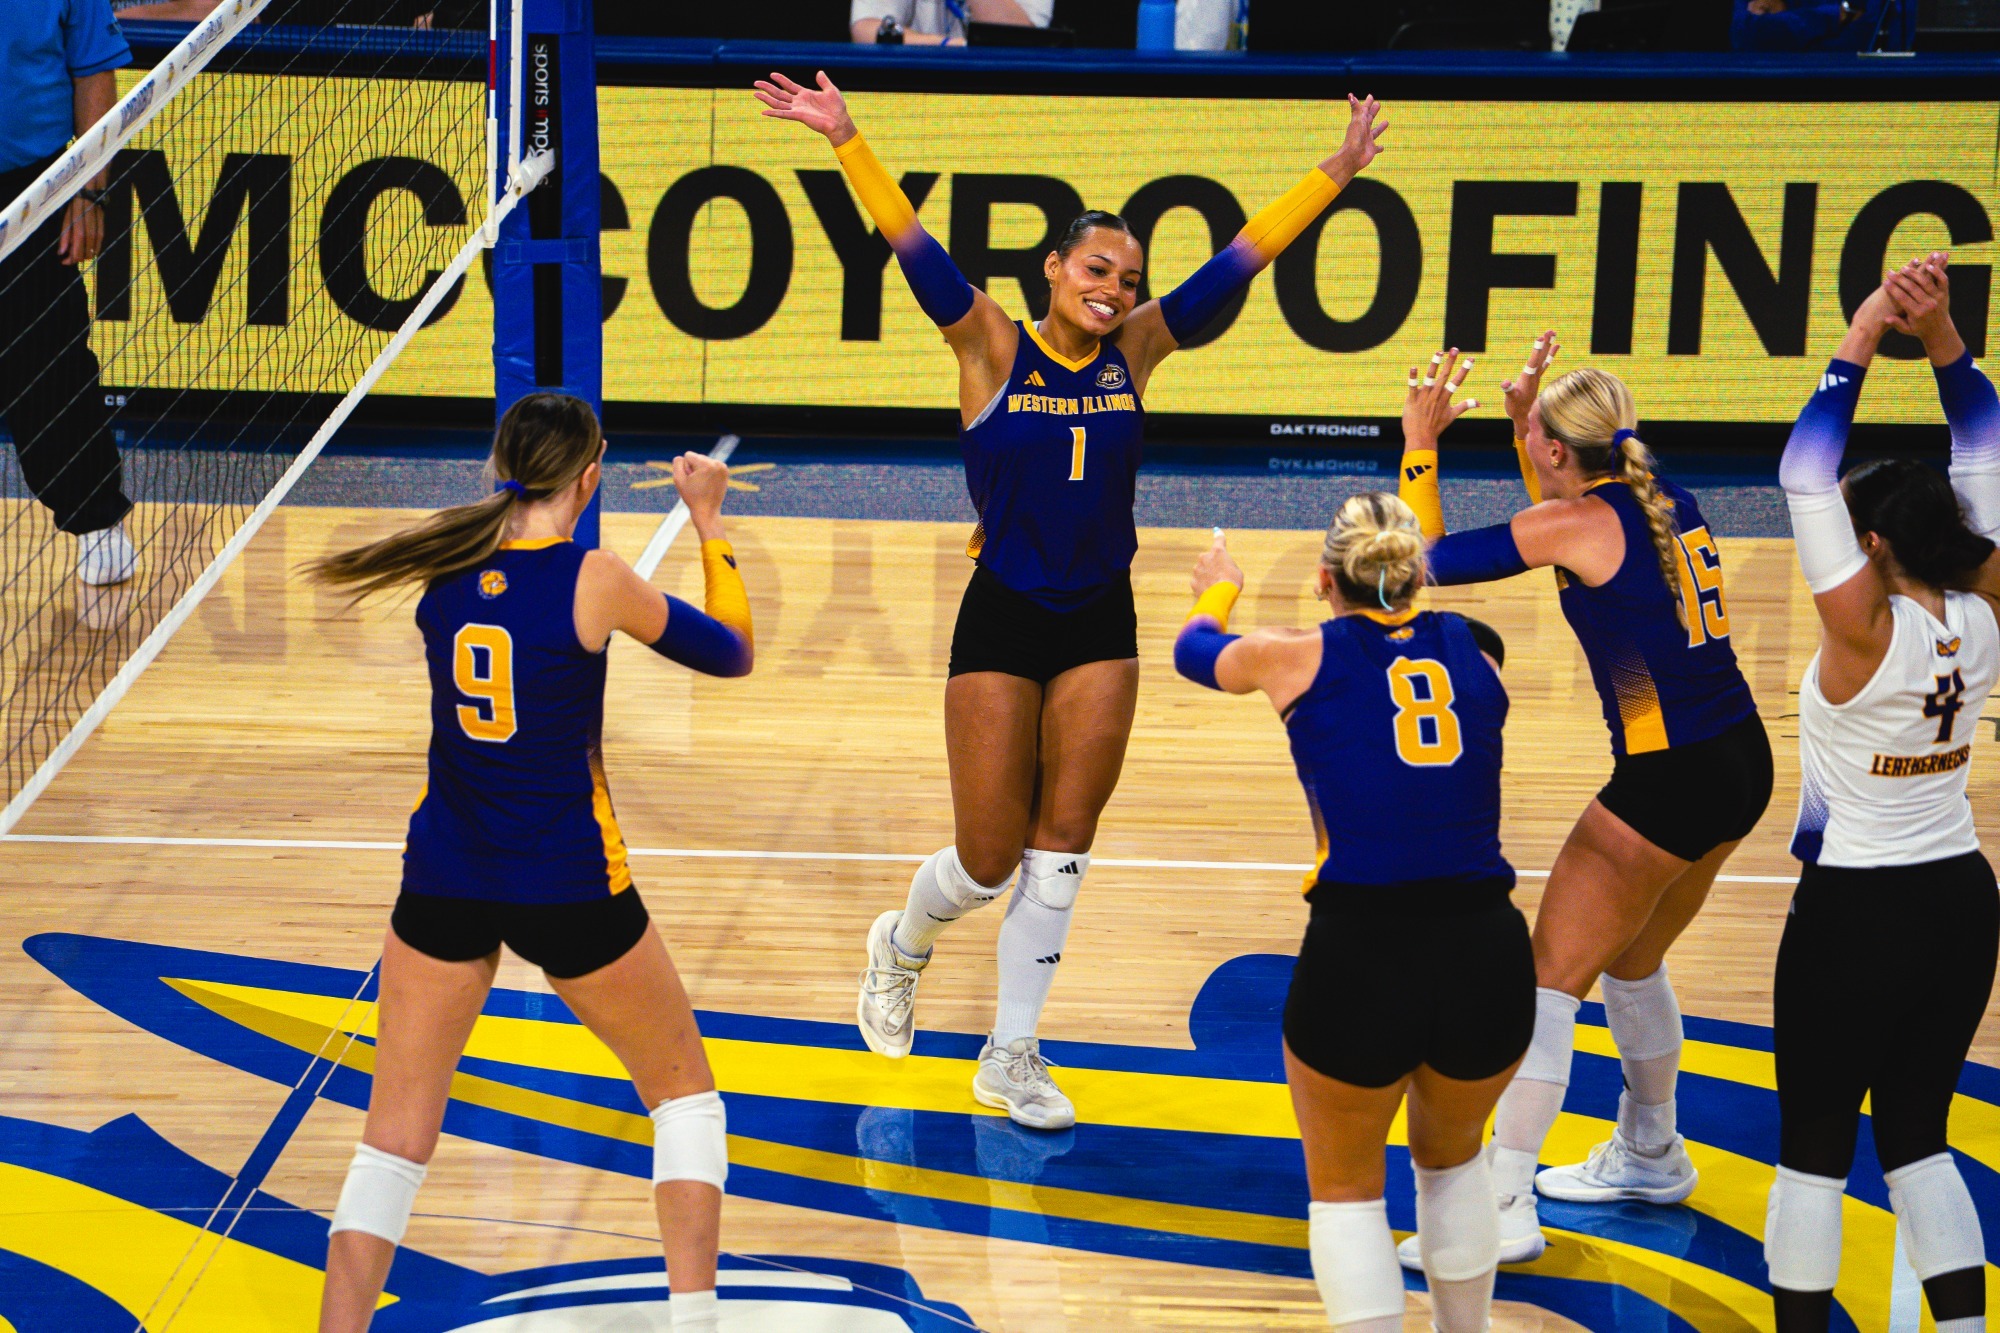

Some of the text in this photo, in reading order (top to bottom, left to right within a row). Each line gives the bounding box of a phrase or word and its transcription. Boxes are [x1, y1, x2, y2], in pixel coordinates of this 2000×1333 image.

[534, 43, 550, 106] sports
[96, 148, 1995, 361] MCOYROOFING
[1007, 393, 1136, 415] WESTERN ILLINOS
[1270, 423, 1380, 437] DAKTRONICS
[1068, 426, 1087, 481] 1
[1673, 525, 1731, 649] 15
[453, 622, 518, 743] 9
[1386, 655, 1464, 768] 8
[1922, 667, 1966, 745] 4
